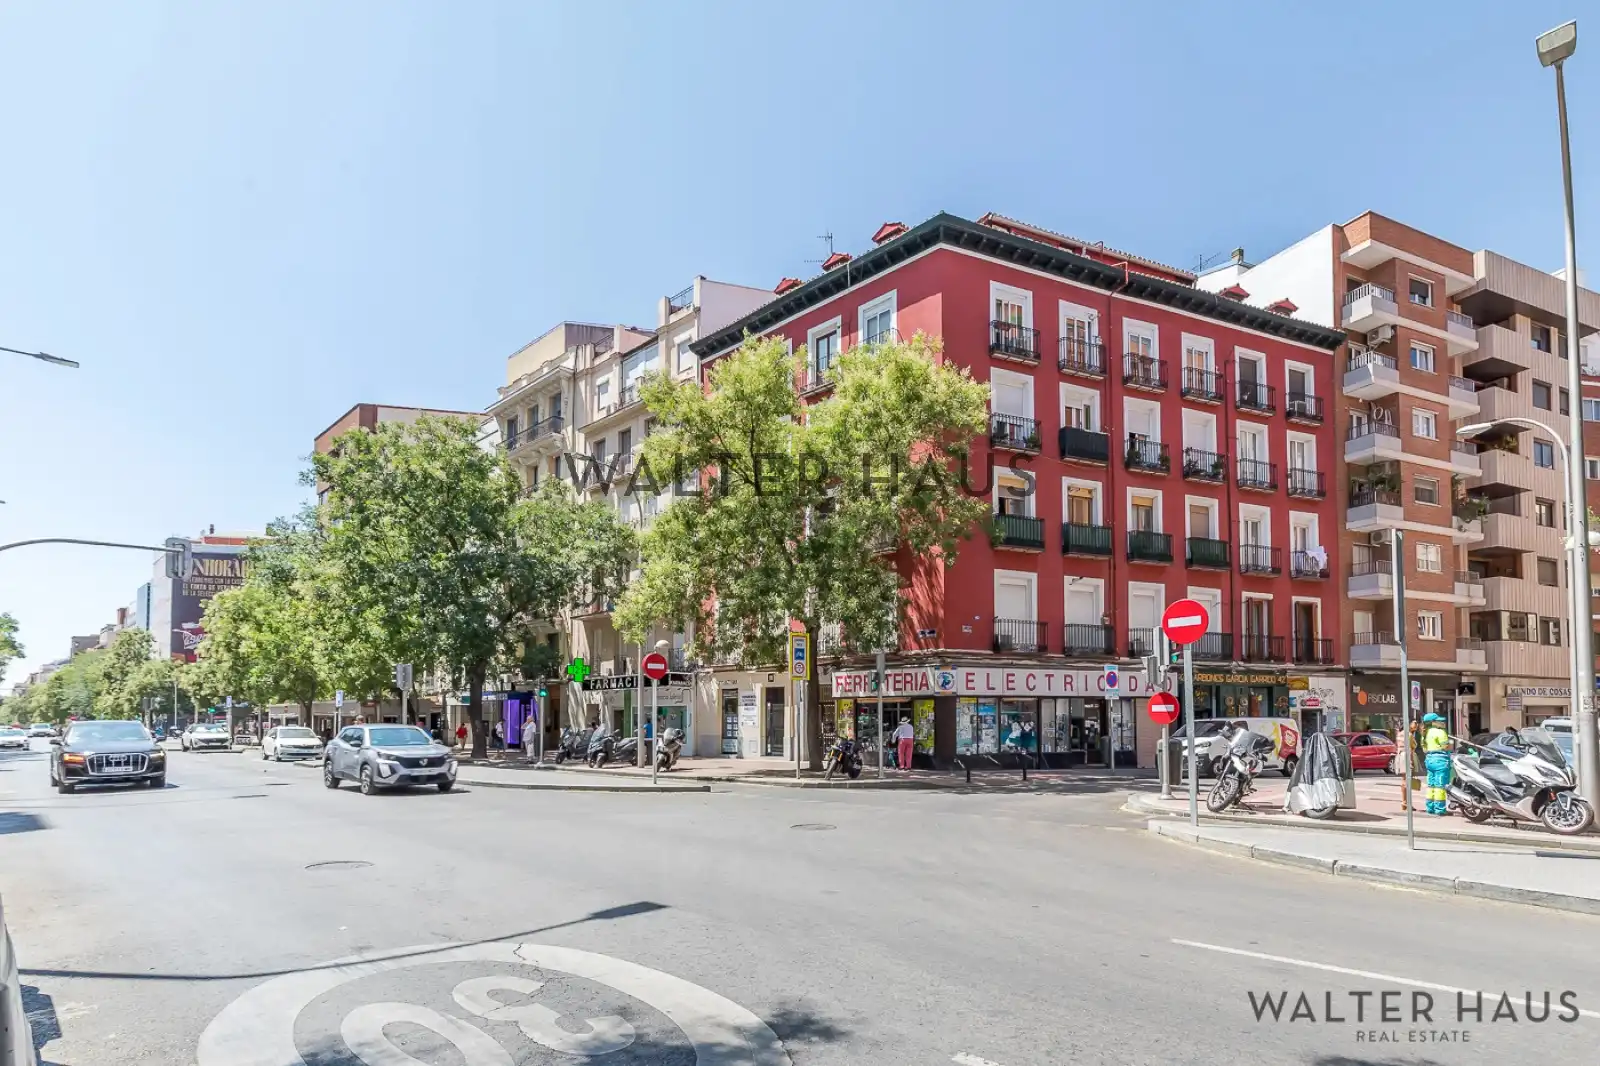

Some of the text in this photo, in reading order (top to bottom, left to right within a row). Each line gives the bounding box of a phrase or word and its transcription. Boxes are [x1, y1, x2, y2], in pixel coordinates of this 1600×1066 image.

[590, 676, 637, 690] FARMACI
[835, 671, 930, 693] FERRTERIA
[964, 672, 1172, 692] ELECTRICDAD
[1511, 687, 1571, 697] MUNDO DE COSAS
